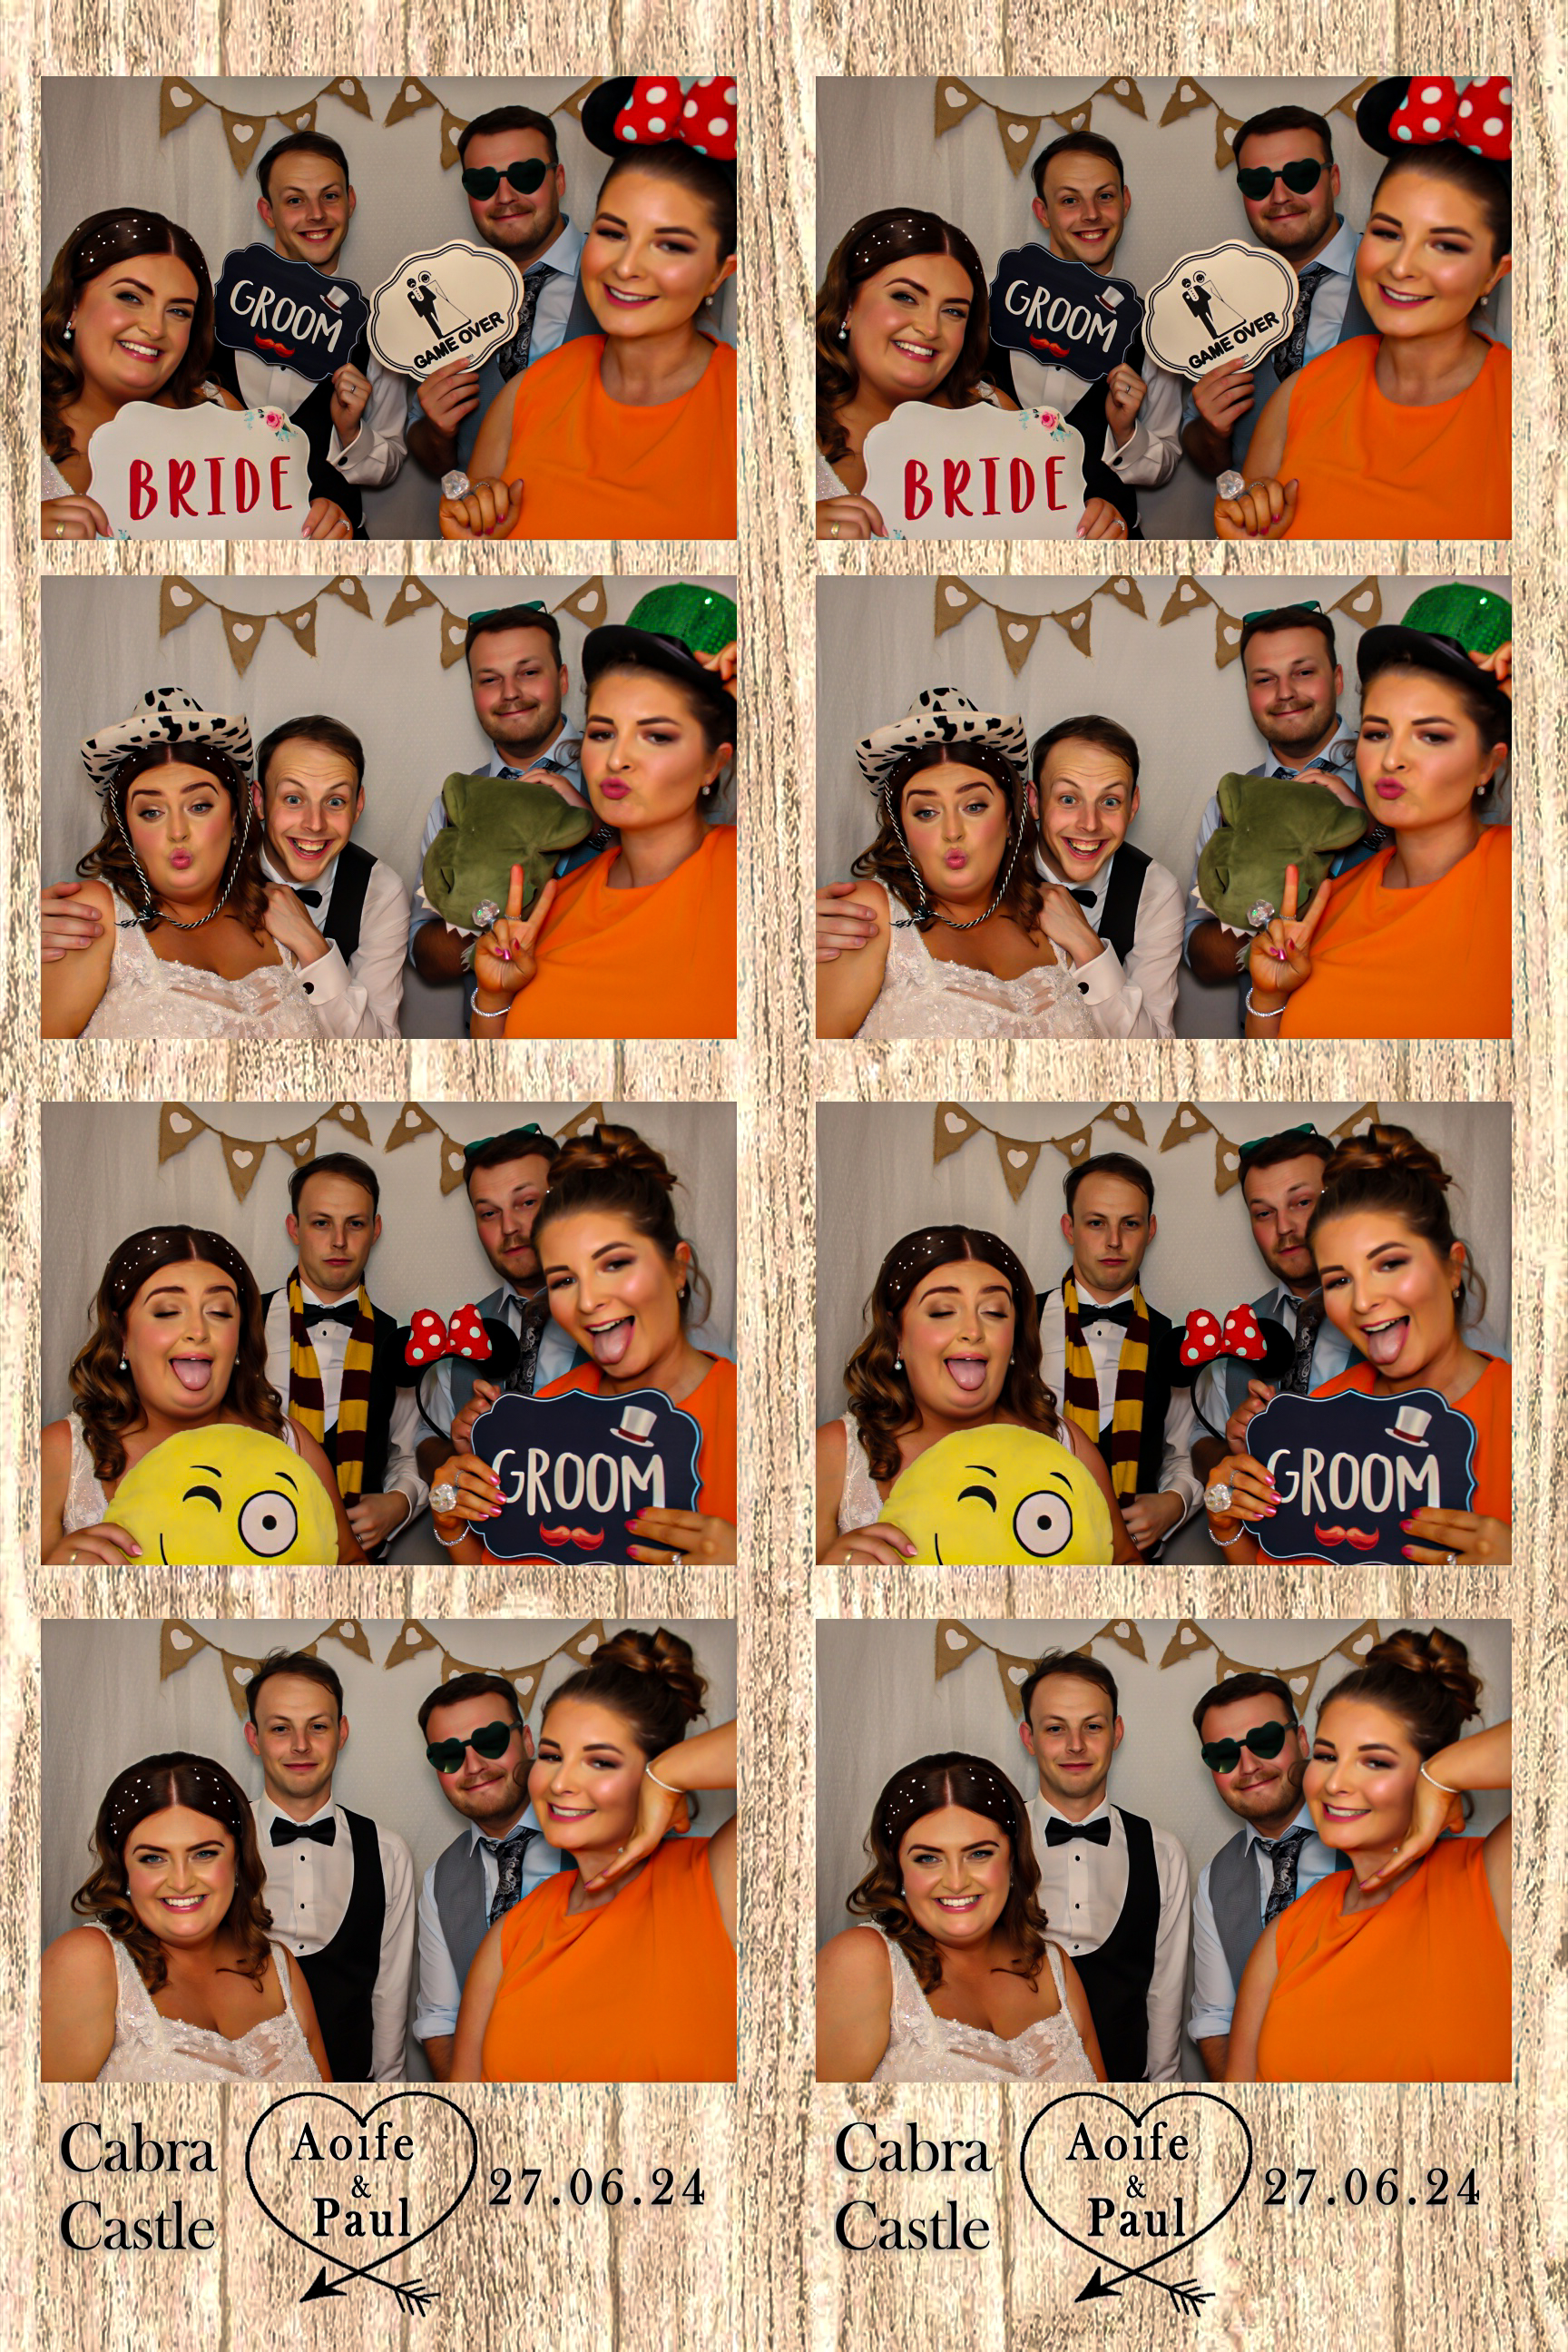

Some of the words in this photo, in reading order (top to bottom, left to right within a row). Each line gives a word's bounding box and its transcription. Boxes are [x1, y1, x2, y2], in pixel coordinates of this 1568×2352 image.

[230, 279, 343, 353] GROOM
[414, 336, 459, 369] GAME
[458, 311, 505, 345] OVER
[1004, 279, 1118, 353] GROOM
[1189, 336, 1234, 369] GAME
[1233, 311, 1280, 345] OVER
[129, 456, 292, 520] BRIDE
[904, 456, 1067, 520] BRIDE
[492, 1448, 666, 1516] GROOM
[1267, 1448, 1441, 1516] GROOM
